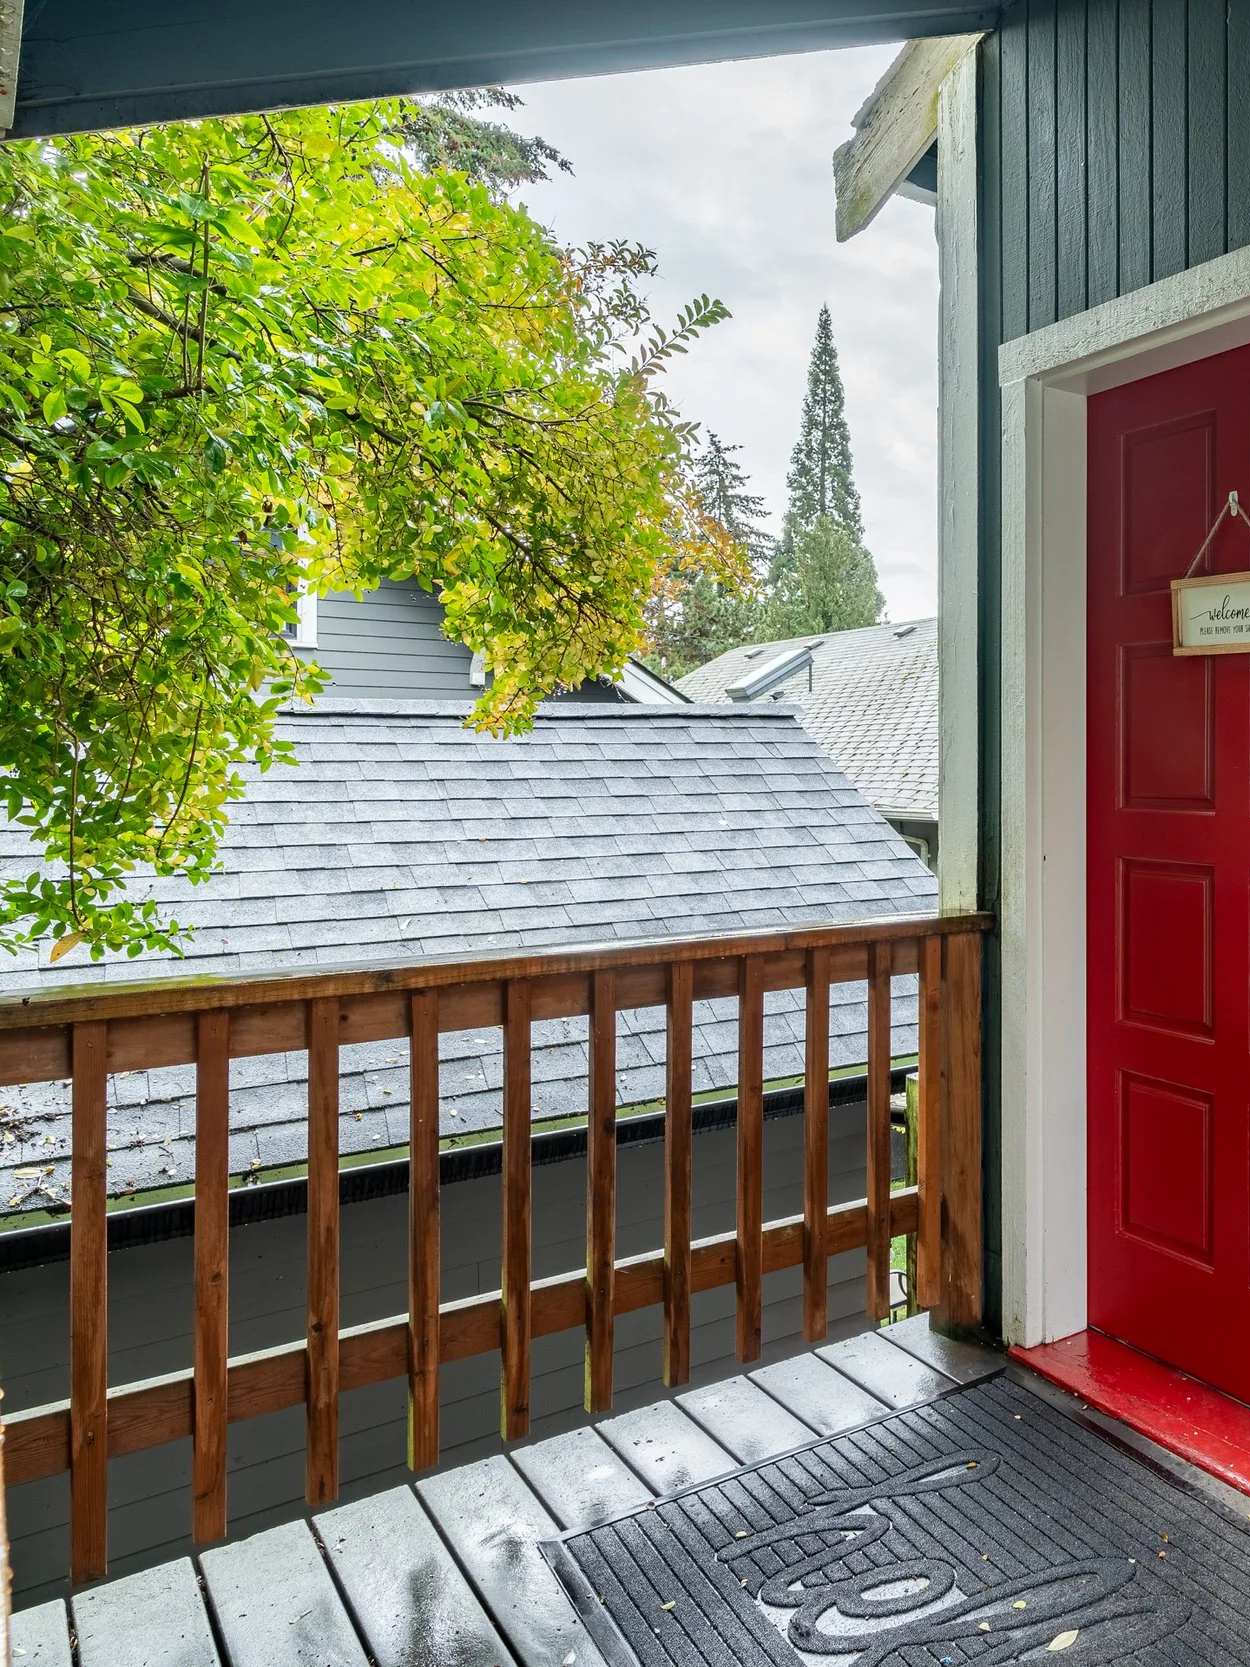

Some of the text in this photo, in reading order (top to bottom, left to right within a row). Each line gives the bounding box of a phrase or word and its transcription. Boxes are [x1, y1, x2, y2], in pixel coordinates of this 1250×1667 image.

[1200, 626, 1214, 635] PLEASE
[1215, 625, 1231, 635] REMOVE
[1233, 624, 1244, 634] YOUR
